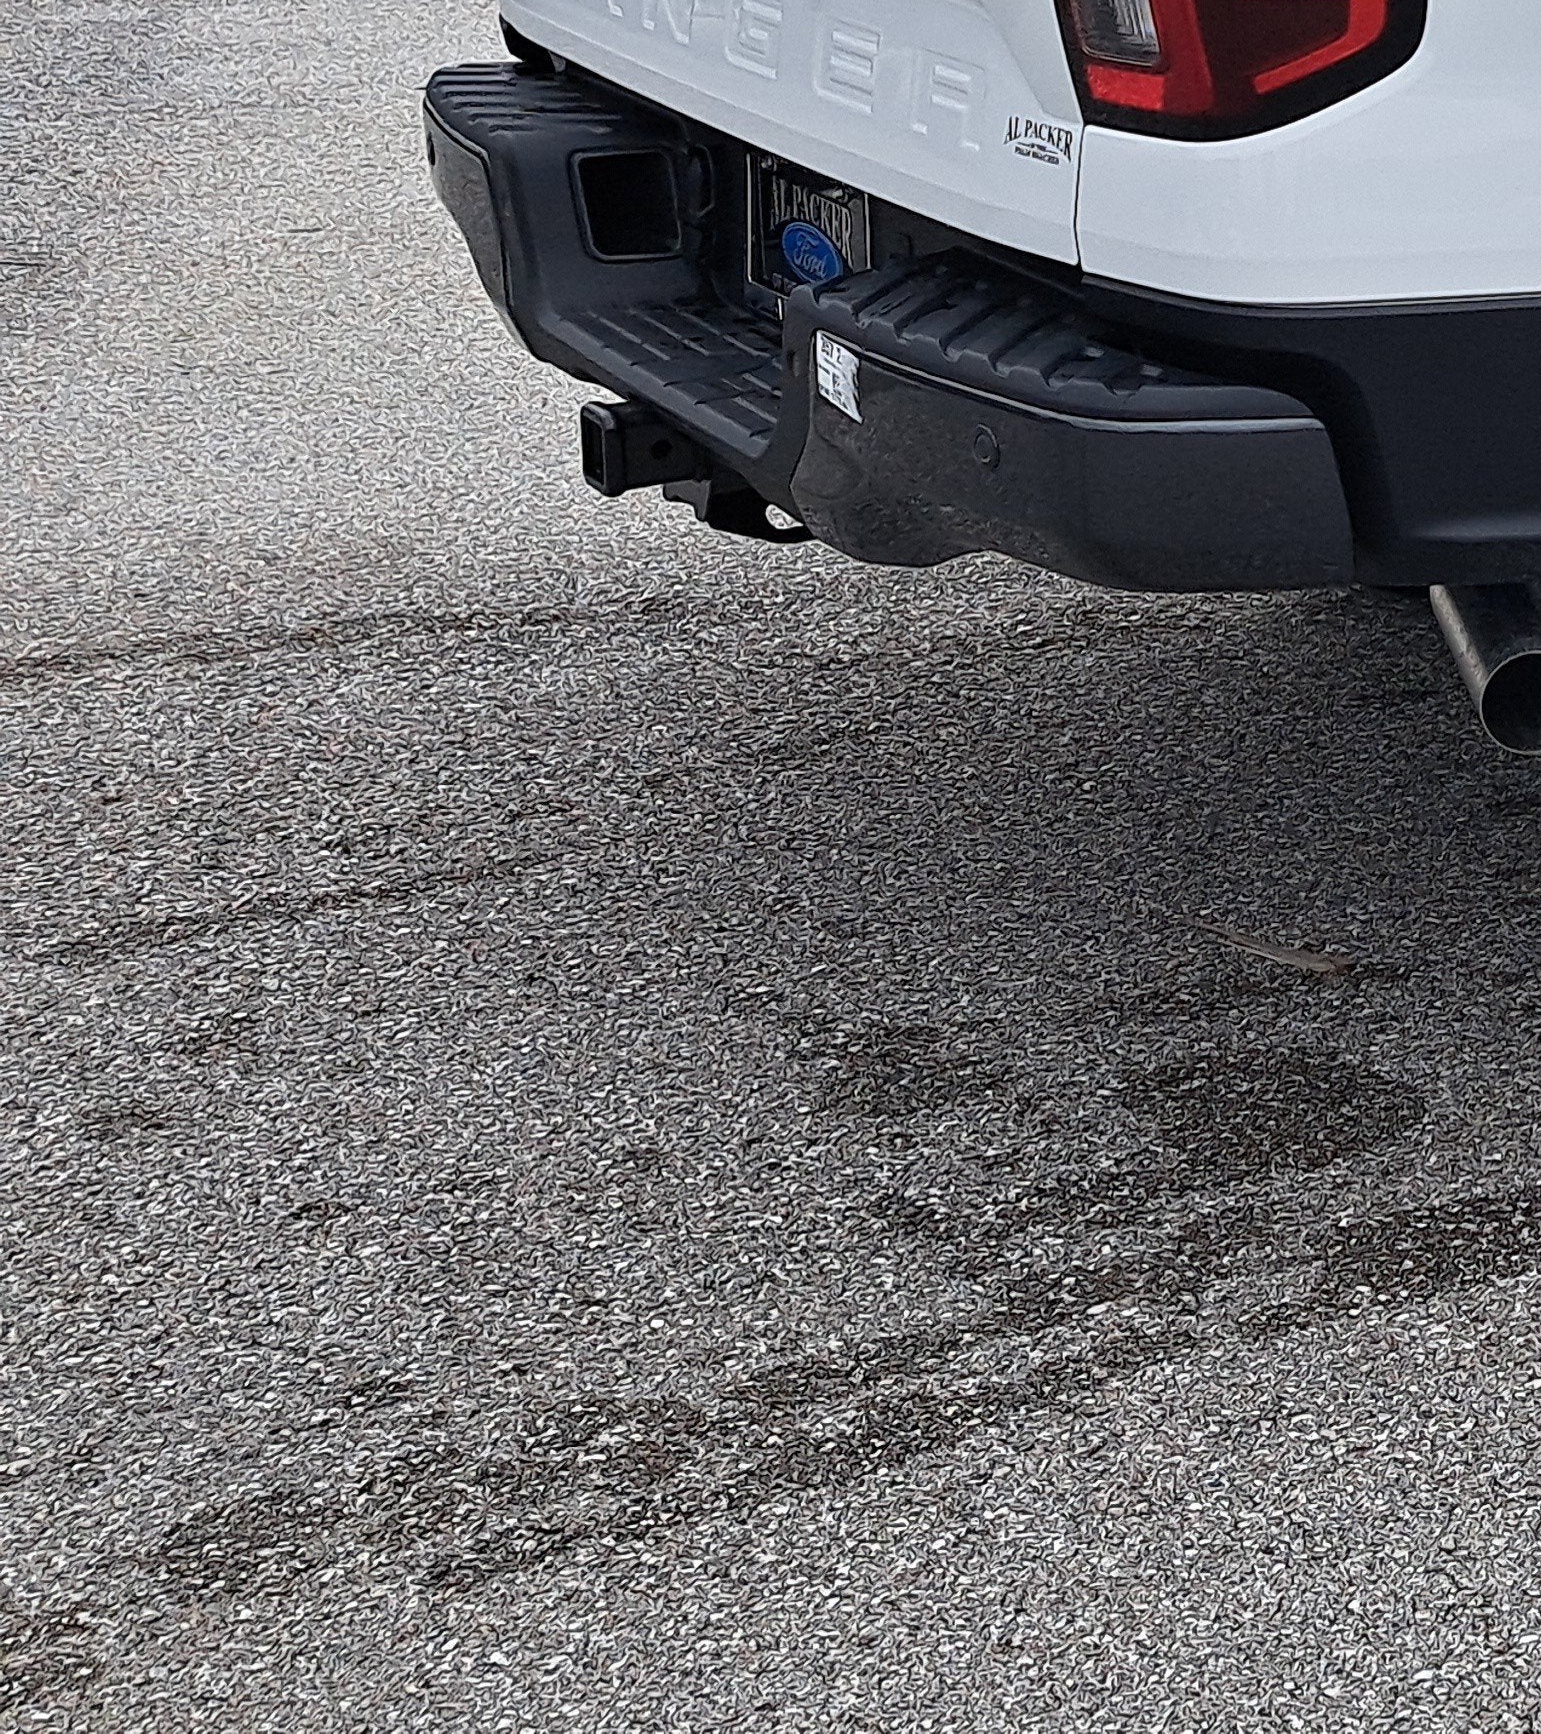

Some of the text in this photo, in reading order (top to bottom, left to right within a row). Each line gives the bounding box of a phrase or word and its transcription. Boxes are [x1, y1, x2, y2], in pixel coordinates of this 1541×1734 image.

[1003, 116, 1021, 145] AL
[1024, 118, 1073, 163] PACKER
[769, 175, 854, 274] AL PACKER
[792, 230, 830, 280] Ford
